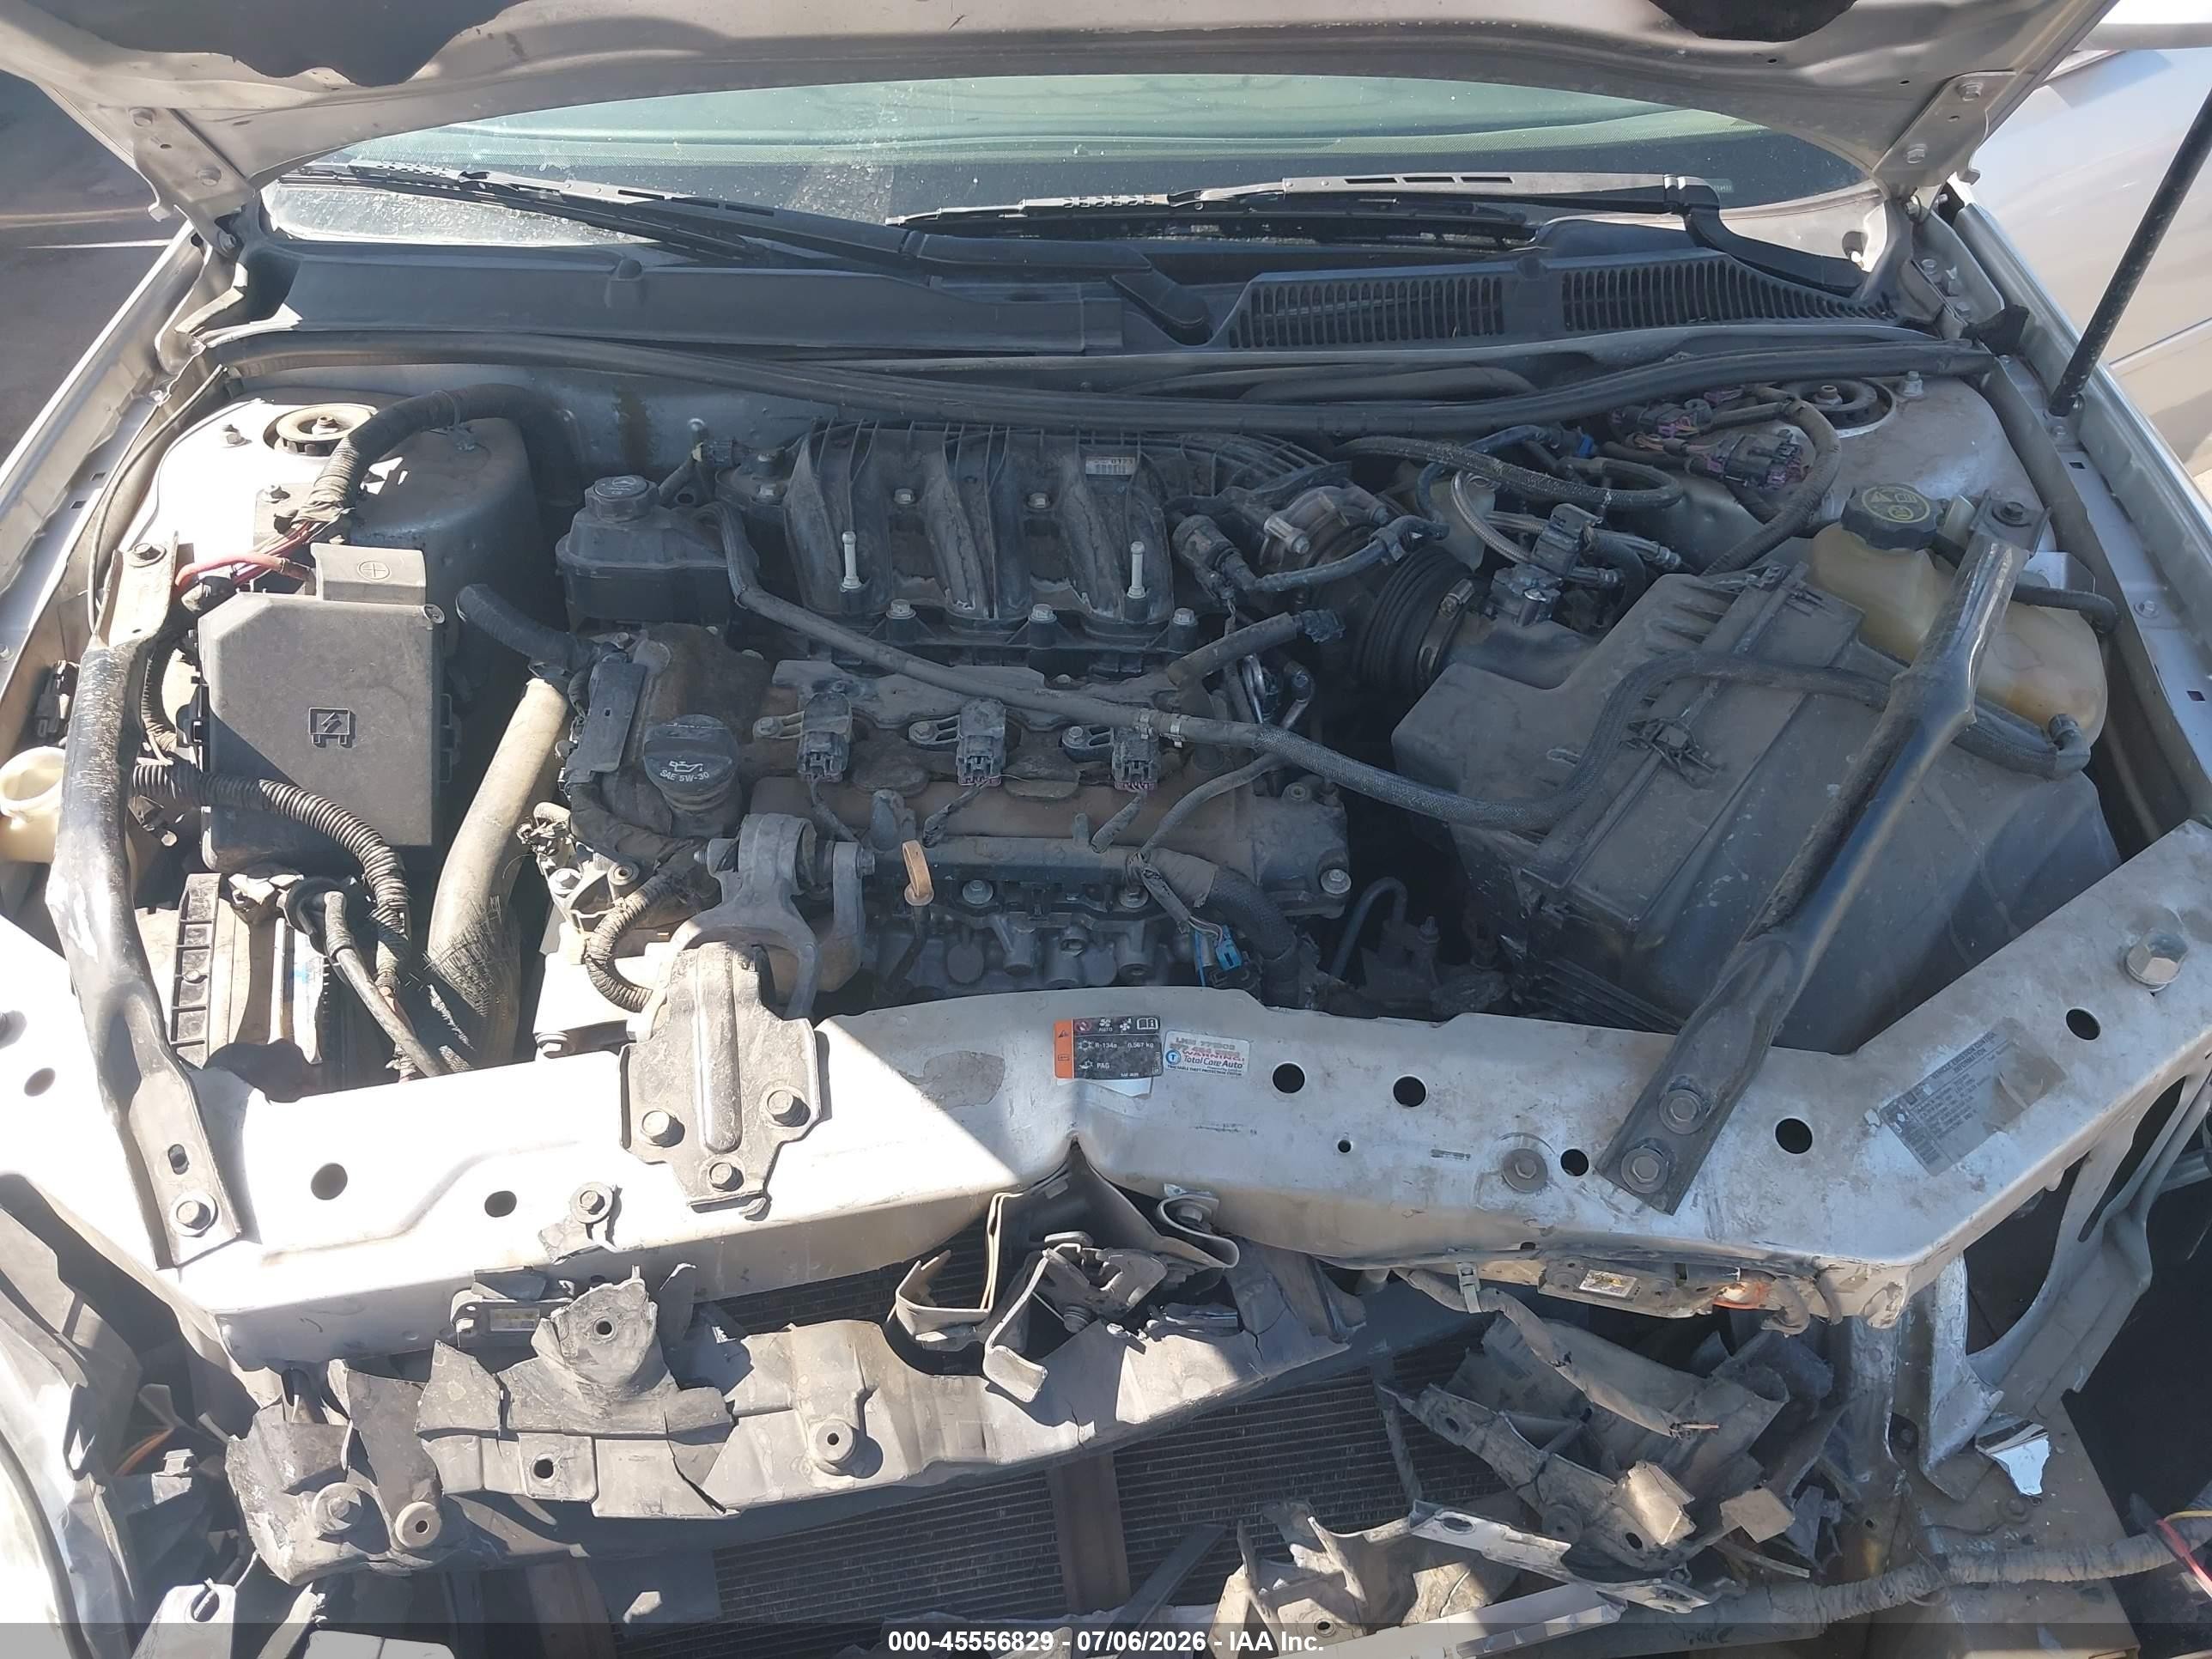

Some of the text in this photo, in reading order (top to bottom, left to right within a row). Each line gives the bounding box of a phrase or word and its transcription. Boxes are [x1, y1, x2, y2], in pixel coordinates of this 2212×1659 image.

[659, 769, 709, 782] SAE 5W-30
[1203, 1057, 1222, 1066] Care
[1221, 1060, 1243, 1069] Auto
